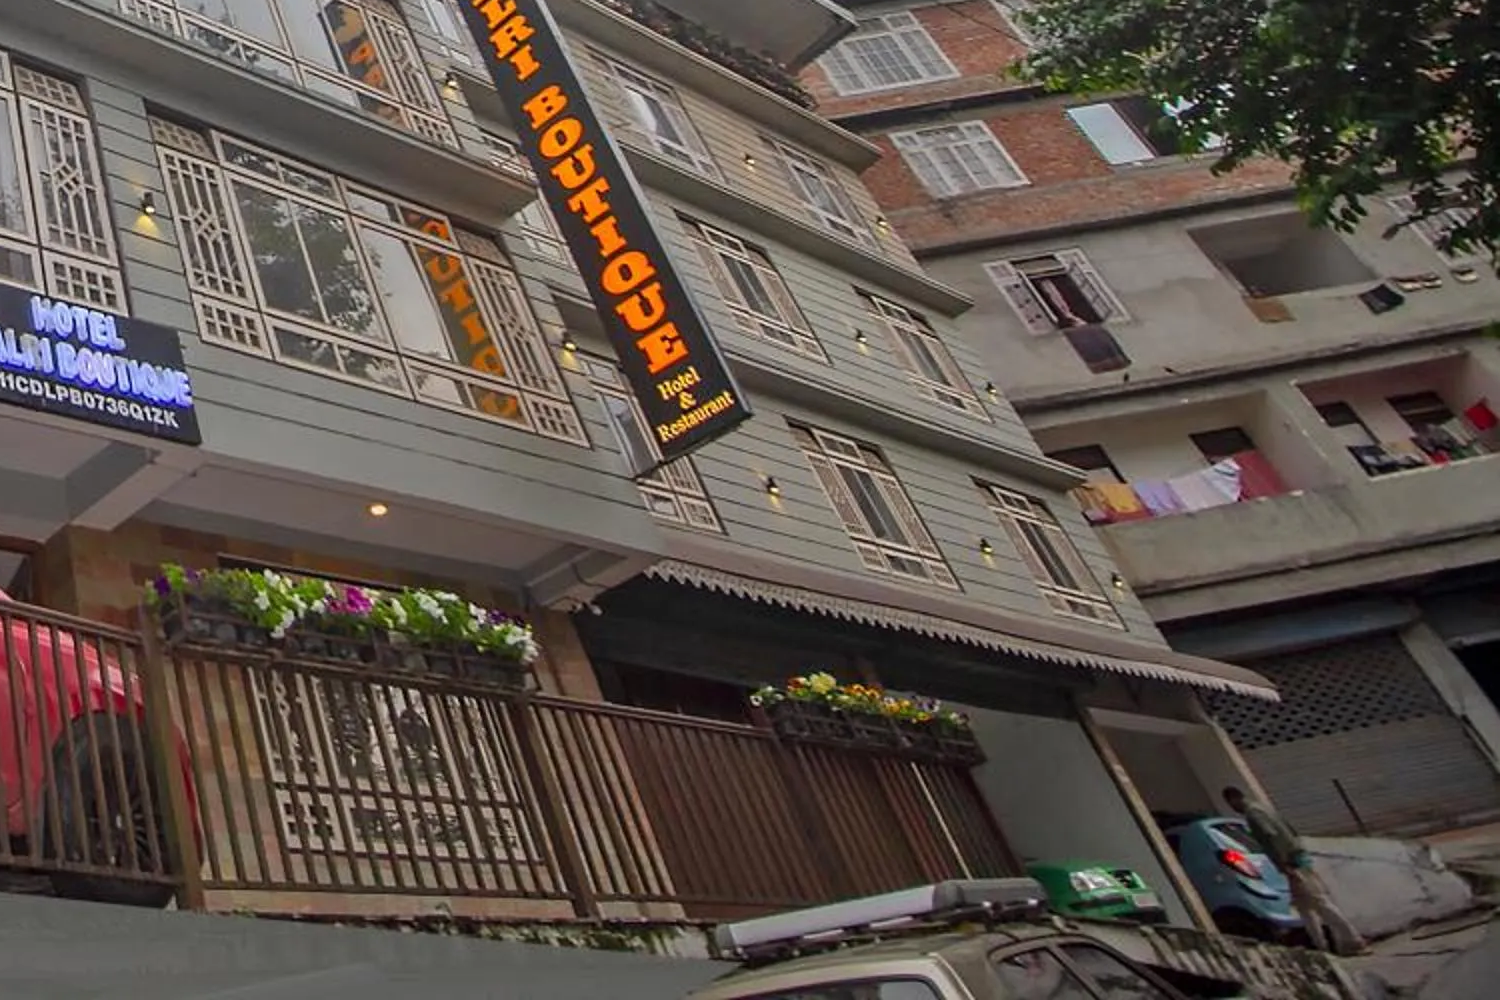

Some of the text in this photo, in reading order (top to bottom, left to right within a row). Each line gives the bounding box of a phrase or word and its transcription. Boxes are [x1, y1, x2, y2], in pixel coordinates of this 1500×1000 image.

[521, 84, 689, 375] BOUTIQUE
[29, 295, 127, 350] HOTEL
[53, 340, 194, 409] BOUTIQUE
[656, 365, 701, 400] Hotel
[678, 391, 697, 411] &
[656, 390, 736, 443] Restaurant
